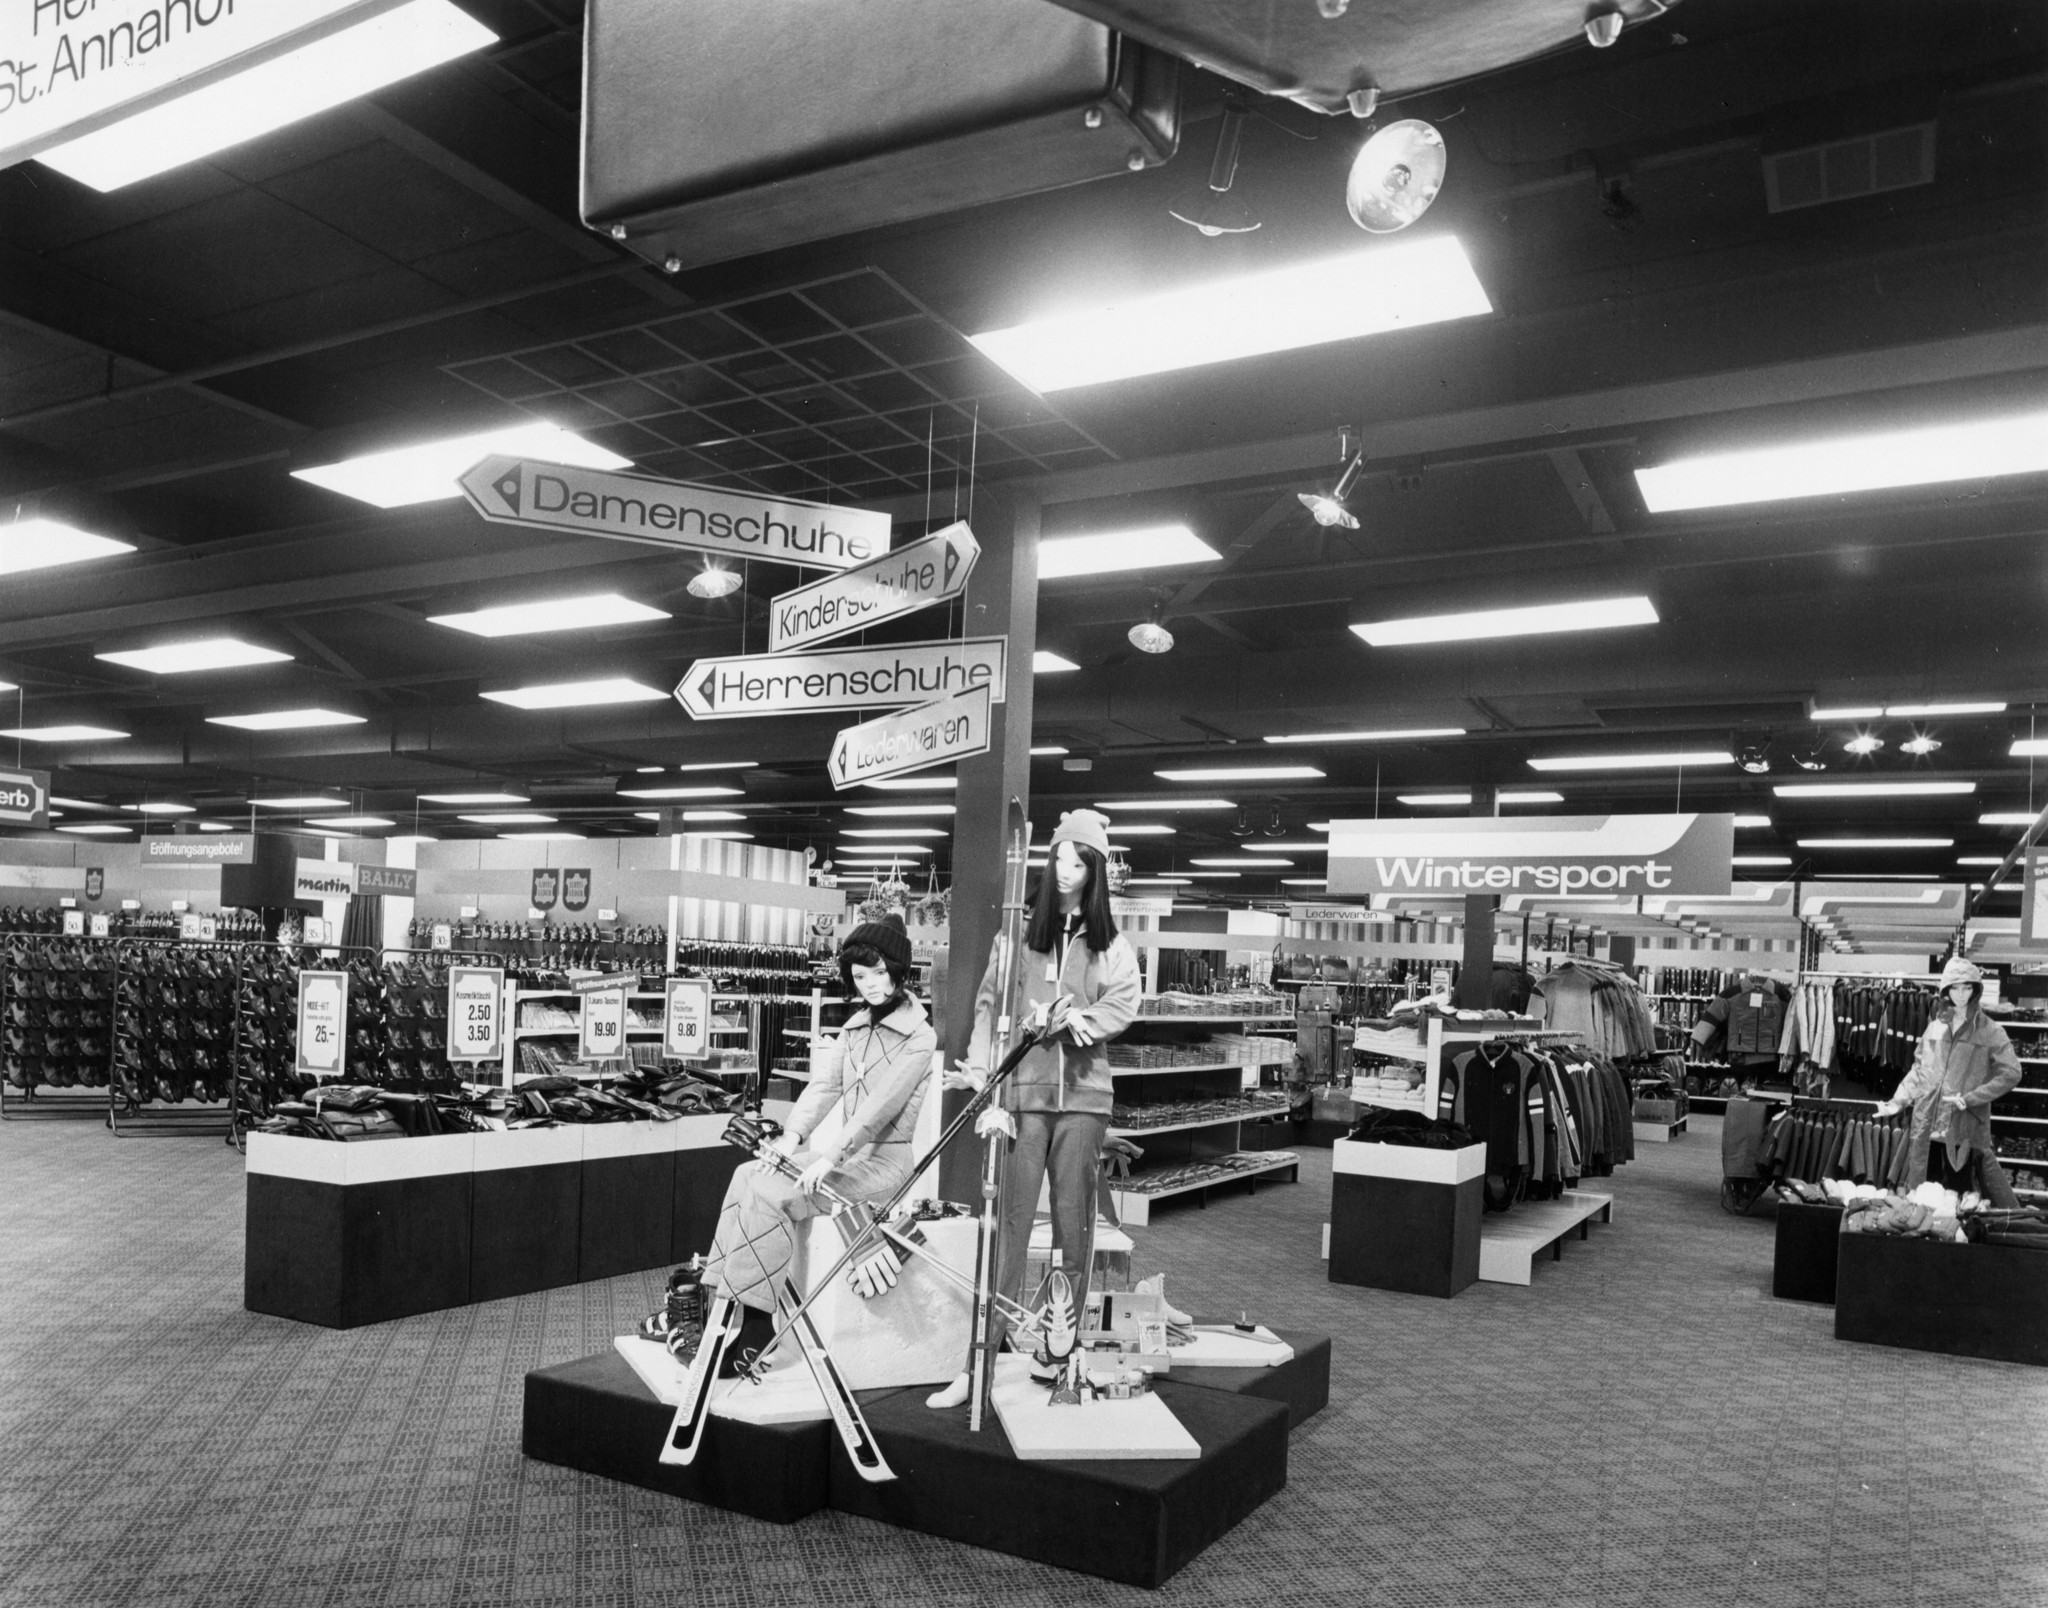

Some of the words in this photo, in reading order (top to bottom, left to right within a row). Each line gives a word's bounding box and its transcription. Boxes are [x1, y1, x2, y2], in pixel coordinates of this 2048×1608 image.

[533, 475, 873, 561] Damenschuhe
[779, 560, 935, 640] Kinderschuhe
[721, 660, 993, 702] Herrenschuhe
[856, 713, 970, 770] Lederwaren
[150, 841, 244, 857] Eröffnungsangebote!
[360, 869, 415, 889] BALLY
[1375, 857, 1672, 895] Wintersport
[297, 877, 350, 895] martin
[1305, 908, 1378, 919] Lederwaren
[468, 1004, 491, 1020] 2.50
[315, 1025, 335, 1043] 25.-
[468, 1025, 490, 1041] 3.50
[594, 1022, 616, 1036] 19.90
[678, 1023, 696, 1037] 9.80
[678, 1364, 705, 1424] ROSSIGNOL
[827, 1388, 860, 1445] ROSSIGNOL
